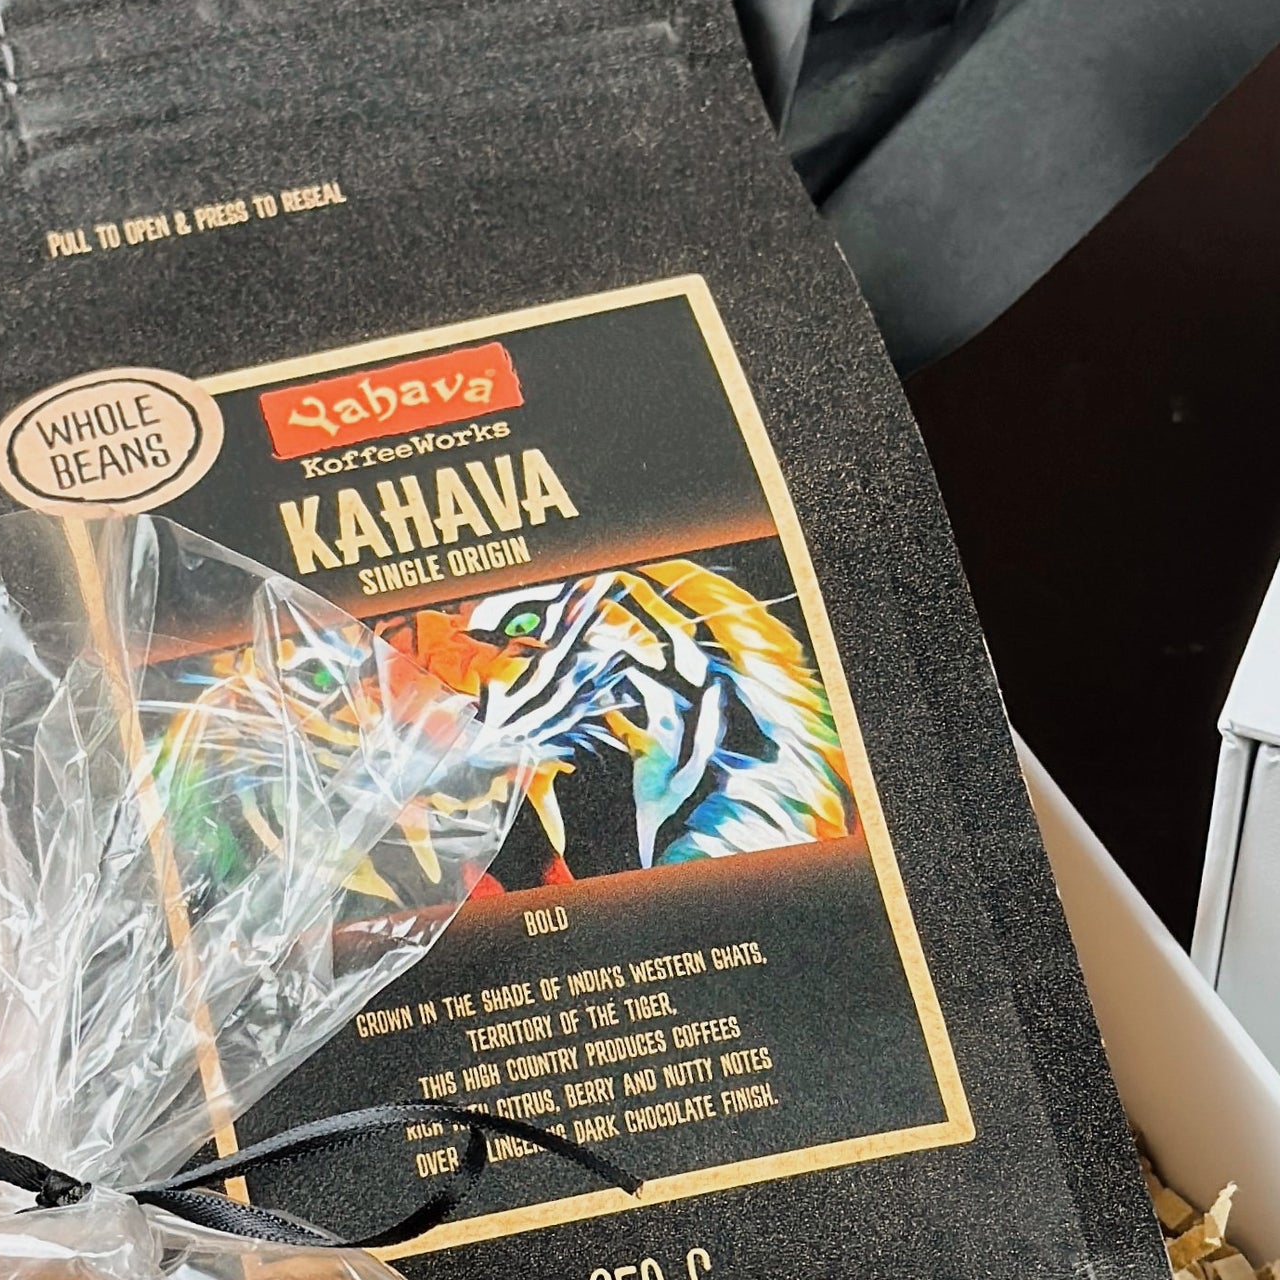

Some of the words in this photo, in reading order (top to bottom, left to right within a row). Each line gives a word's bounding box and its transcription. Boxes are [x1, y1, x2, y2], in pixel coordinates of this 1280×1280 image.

[47, 229, 92, 258] PULL
[97, 223, 120, 249] TO
[125, 215, 170, 246] OPEN
[175, 211, 191, 235] &
[194, 201, 248, 230] PRESS
[253, 195, 278, 220] TO
[282, 183, 346, 213] RESEAL
[36, 393, 161, 449] WHOLE
[289, 372, 496, 437] Yahava
[50, 433, 171, 491] BEANS
[300, 421, 511, 479] KoffeeWorks
[278, 448, 579, 575] KAHAVA
[358, 549, 445, 596] SINGLE
[453, 536, 531, 578] ORIGIN
[524, 906, 569, 937] BOLD
[356, 1005, 413, 1038] GROWN
[419, 1000, 438, 1024] IN
[442, 993, 476, 1020] THE
[481, 982, 535, 1013] SHADE
[540, 977, 561, 1001] OF
[567, 965, 625, 996] INDIA'S
[629, 950, 706, 984] WESTERN
[711, 941, 768, 970] GHATS,
[466, 1015, 553, 1053] TERRITORY
[560, 1009, 580, 1035] OF
[586, 1003, 619, 1029] THE
[624, 992, 677, 1023] TIGER,
[418, 1071, 457, 1099] THIS
[462, 1064, 501, 1092] HIGH
[506, 1046, 578, 1081] COUNTRY
[585, 1029, 667, 1067] PRODUCES
[672, 1016, 741, 1049] COFFEES
[564, 1077, 615, 1109] BERRY
[623, 1068, 657, 1096] AND
[663, 1058, 713, 1088] NUTTY
[720, 1047, 773, 1077] NOTES
[416, 1147, 459, 1178] OVER
[574, 1115, 620, 1145] DARK
[624, 1094, 716, 1133] CHOCOLATE
[721, 1082, 779, 1115] FINISH.
